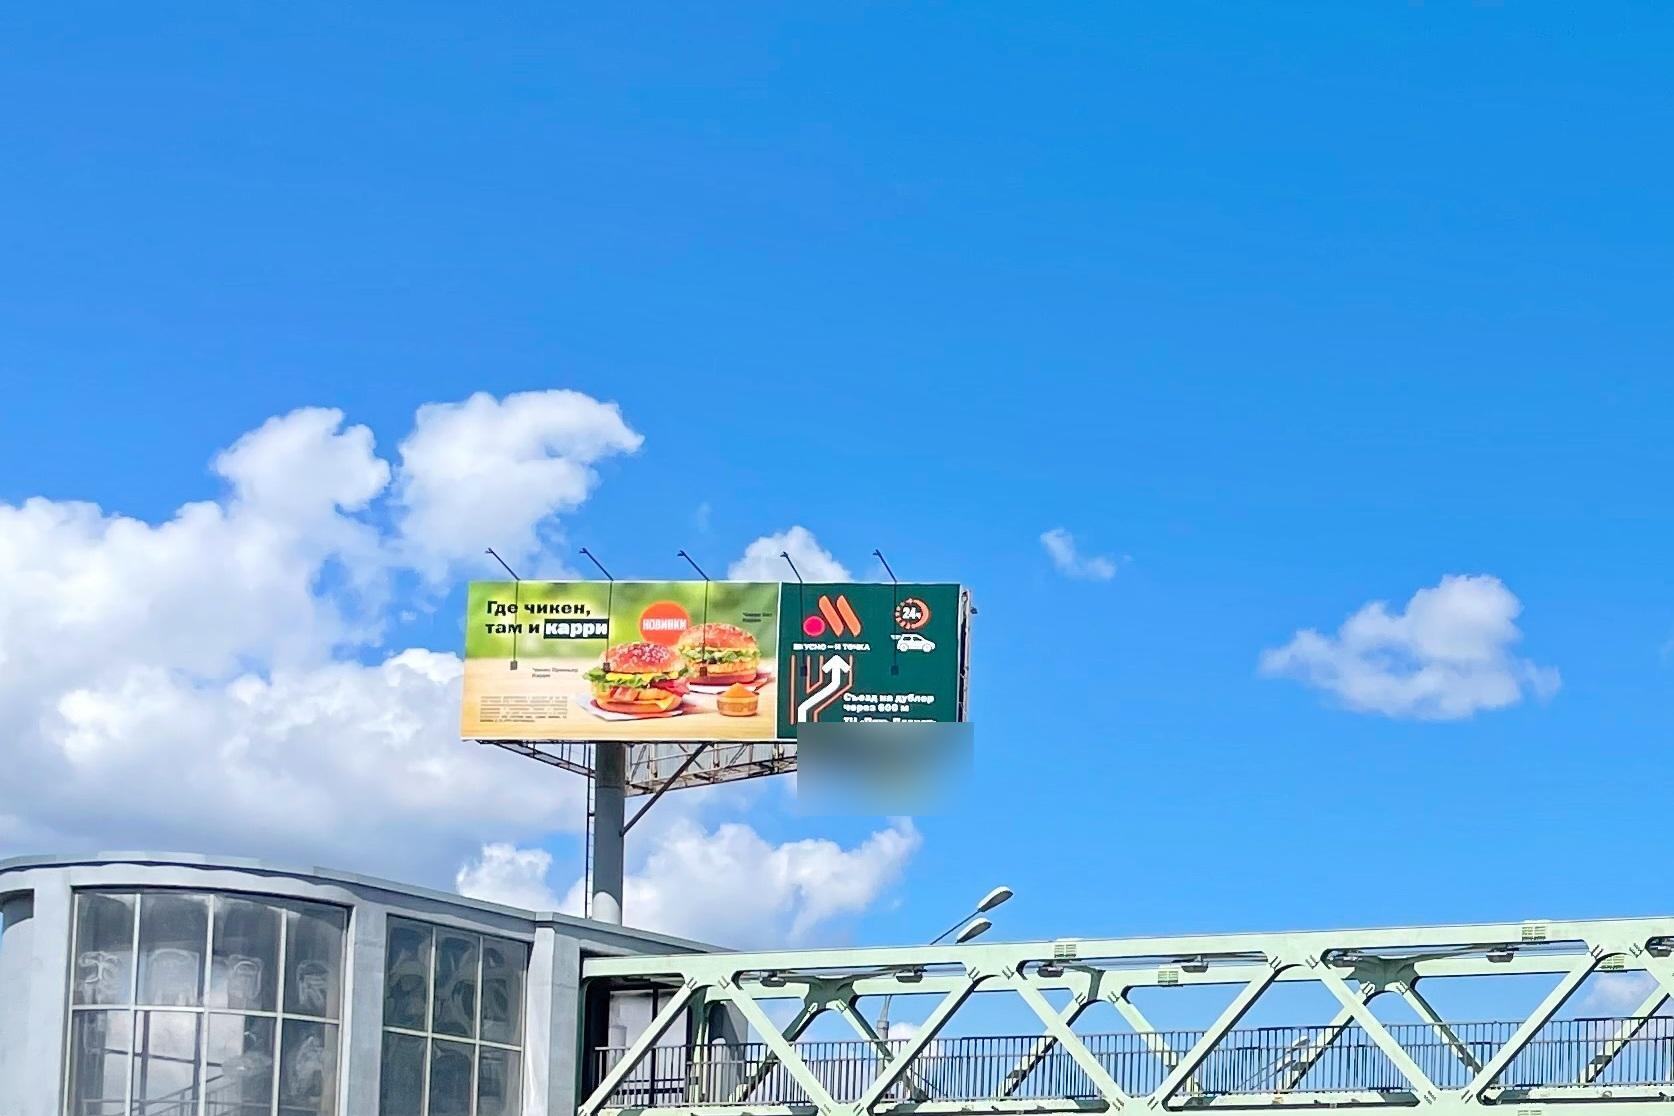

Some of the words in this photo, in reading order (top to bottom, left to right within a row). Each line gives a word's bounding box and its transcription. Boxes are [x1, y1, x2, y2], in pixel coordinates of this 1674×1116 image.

[487, 600, 518, 617] Где
[524, 602, 591, 617] чикен,
[485, 623, 522, 634] там
[528, 623, 540, 634] и
[545, 621, 608, 638] карри
[642, 618, 688, 631] НОВИНКИ
[843, 692, 878, 703] Съезд
[879, 694, 893, 703] на
[843, 704, 876, 713] через
[877, 703, 898, 712] 600
[900, 704, 910, 712] м
